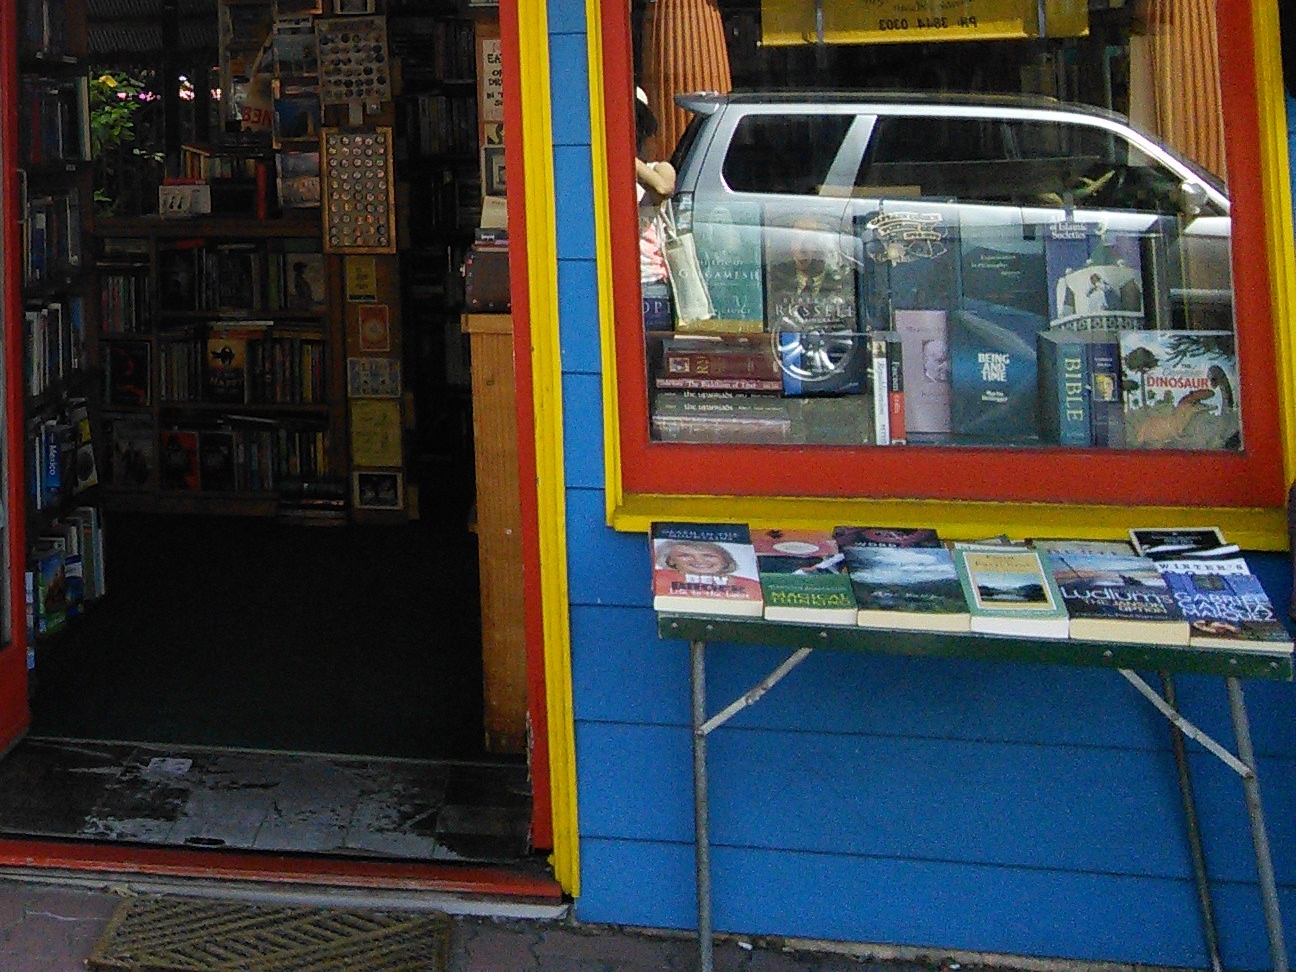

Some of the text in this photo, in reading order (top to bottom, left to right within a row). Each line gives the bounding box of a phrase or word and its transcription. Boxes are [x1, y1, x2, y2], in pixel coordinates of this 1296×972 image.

[977, 352, 1010, 365] BEING
[981, 363, 1007, 373] AND
[1146, 376, 1210, 389] DINOSAUR
[1064, 357, 1084, 422] BIBLE
